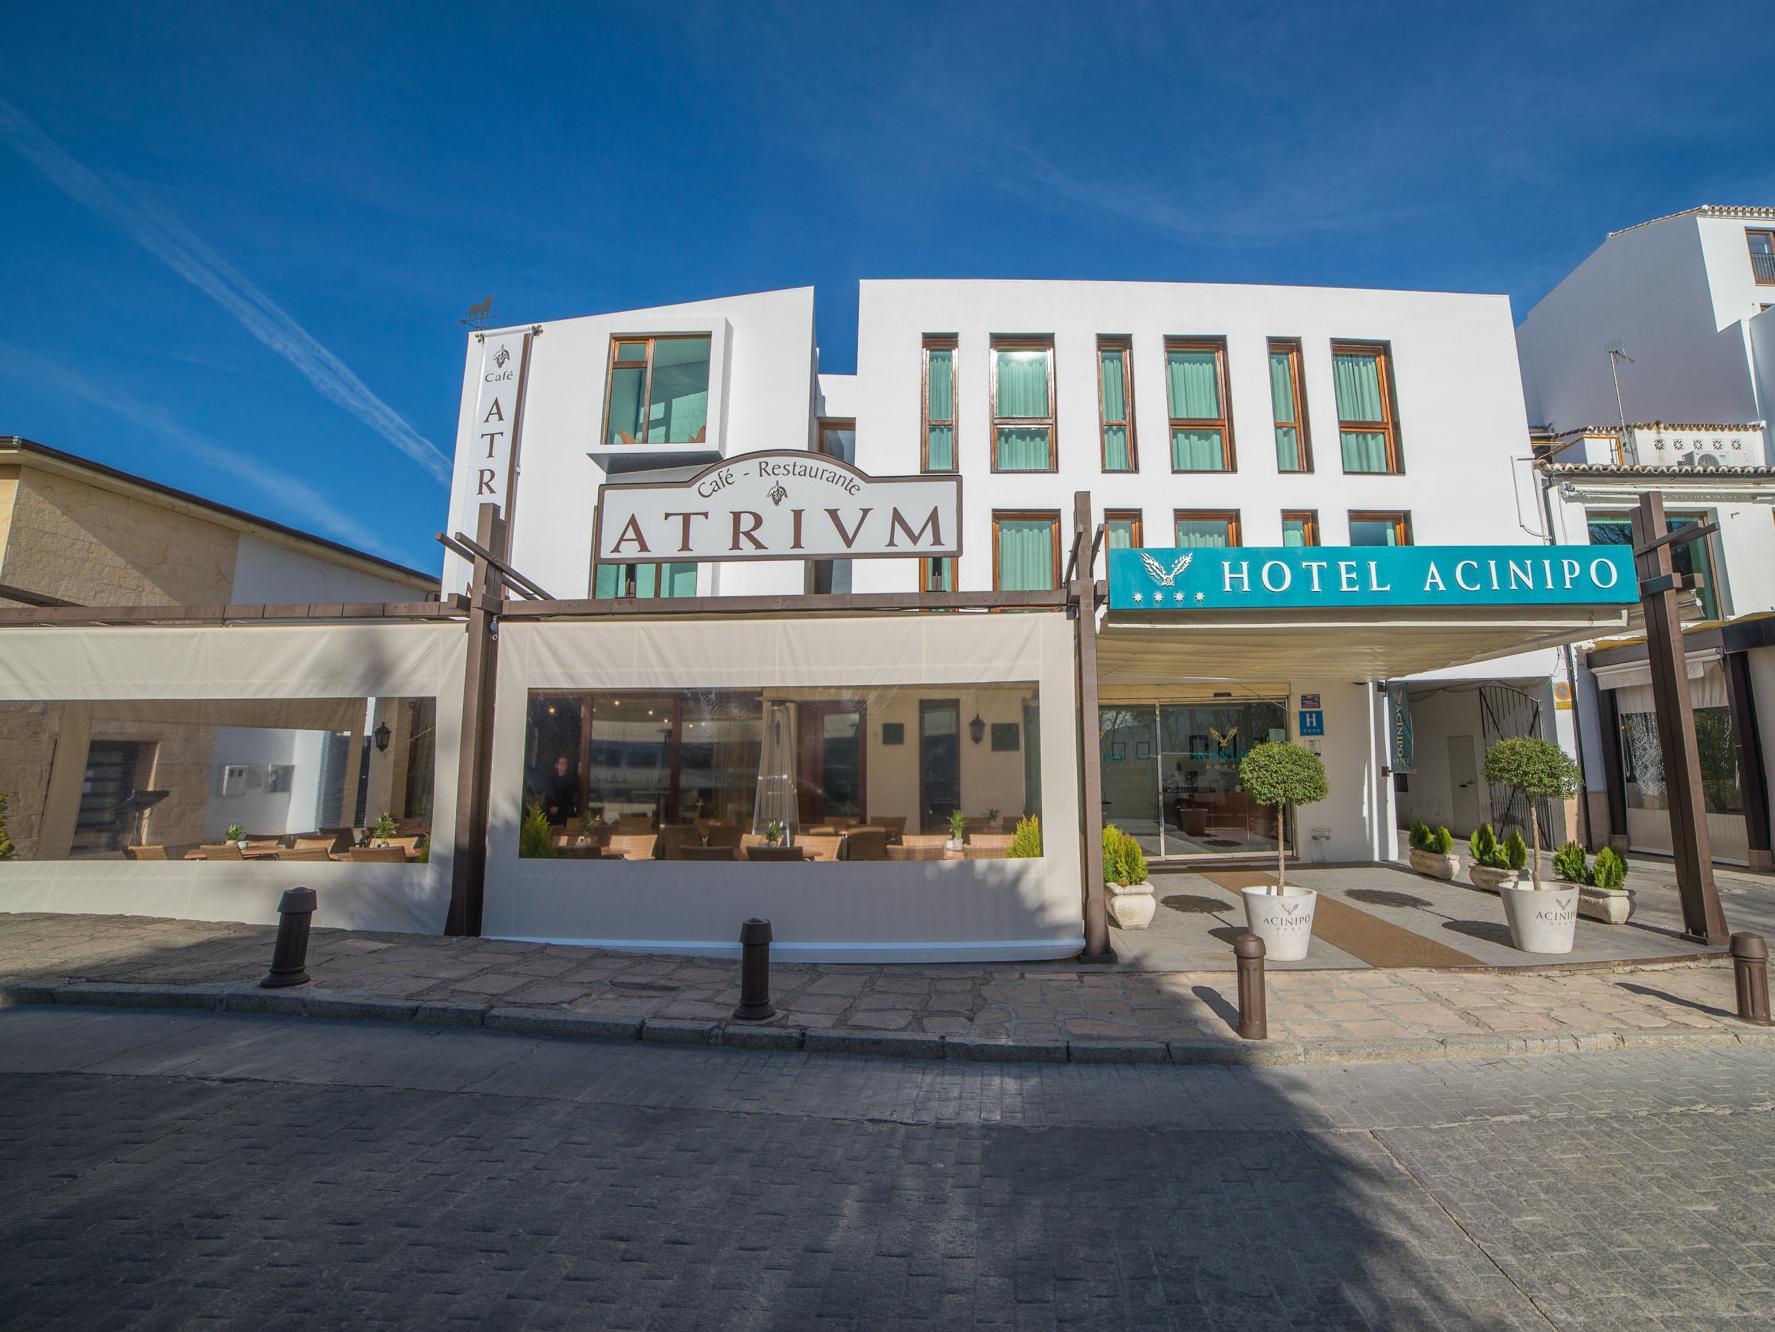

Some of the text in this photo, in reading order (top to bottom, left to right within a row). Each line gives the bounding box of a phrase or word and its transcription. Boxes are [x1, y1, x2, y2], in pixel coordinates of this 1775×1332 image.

[485, 370, 514, 382] Café
[476, 397, 504, 495] ATR
[697, 468, 735, 499] Café
[758, 460, 861, 496] Restaurante
[610, 505, 945, 554] ATRIVM
[1221, 557, 1619, 593] HOTEL ACINIPO
[1306, 712, 1317, 727] H
[1395, 703, 1404, 757] ACINIPO
[1263, 912, 1311, 926] ACINIPO
[1535, 910, 1576, 921] ACINIP
